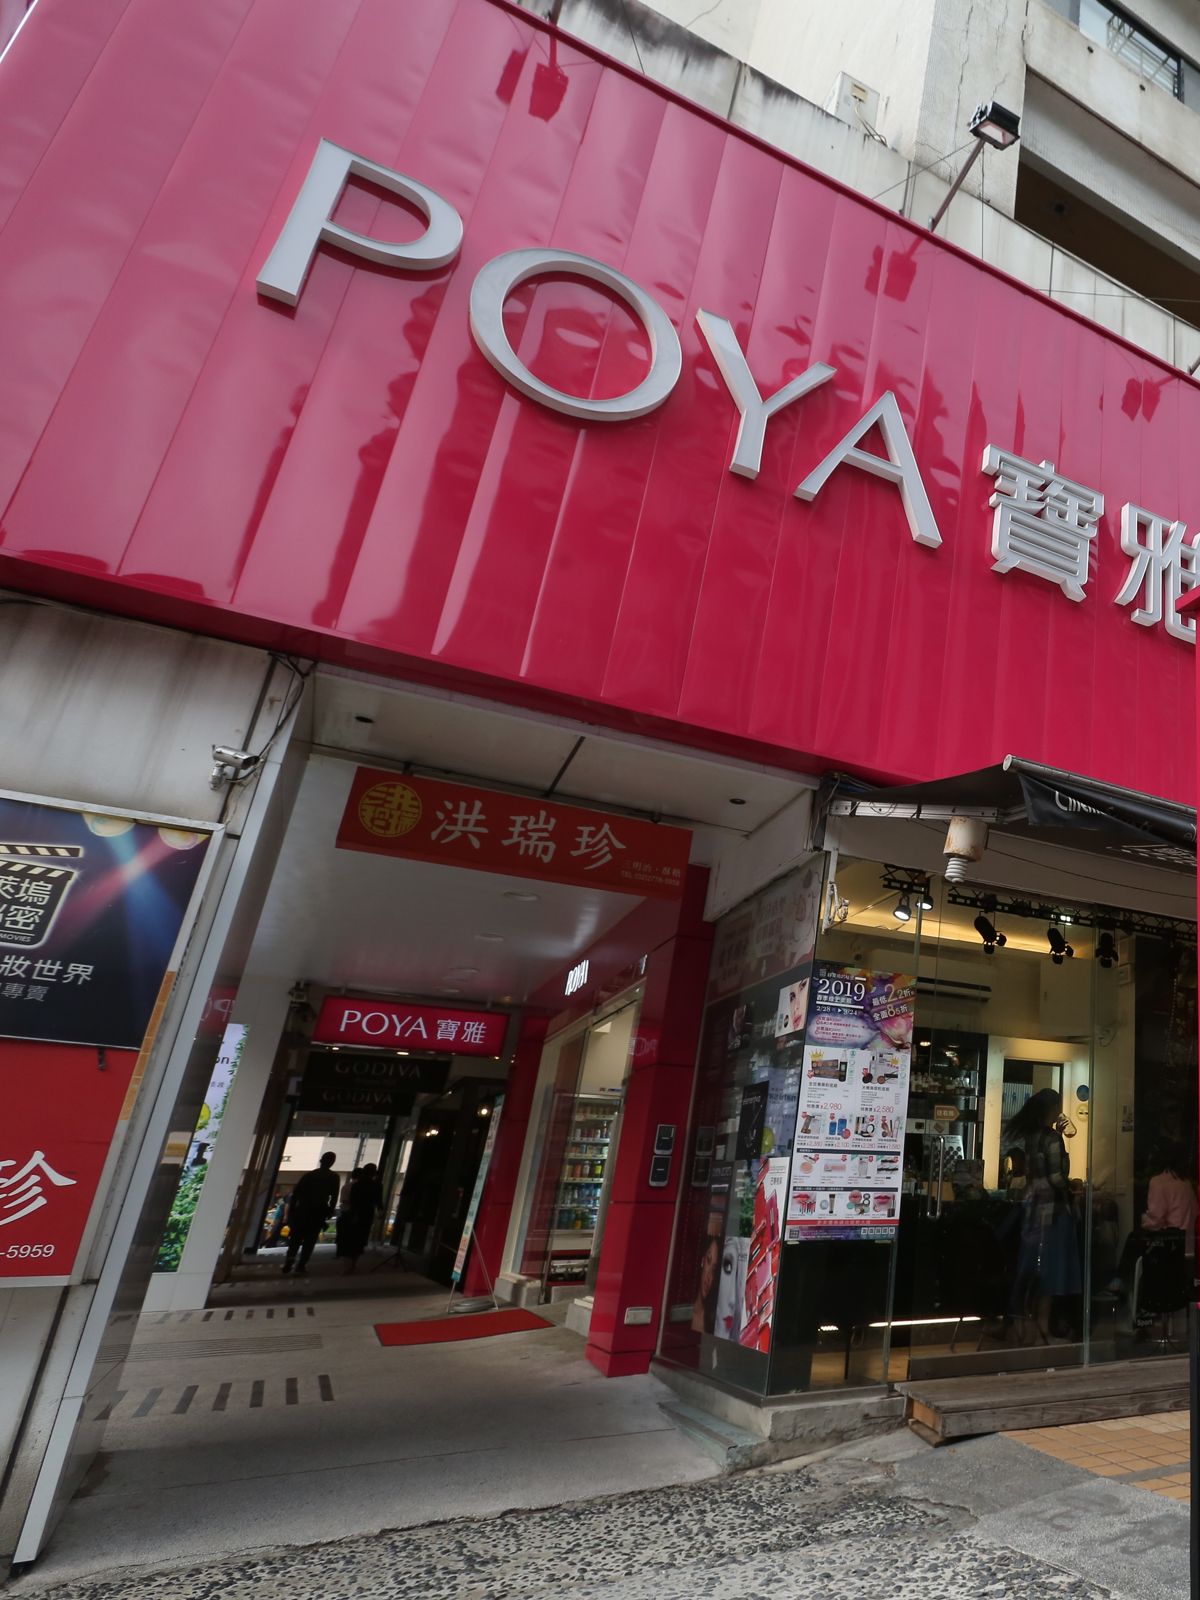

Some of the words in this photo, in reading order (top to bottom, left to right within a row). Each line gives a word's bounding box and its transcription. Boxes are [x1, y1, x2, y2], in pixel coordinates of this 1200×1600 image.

[256, 137, 942, 549] POYA
[430, 800, 626, 870] 洪瑞珍
[818, 978, 866, 1002] 2019
[339, 1009, 427, 1039] POYA
[436, 1019, 487, 1044] 寶雅
[335, 1060, 421, 1079] GODIVA
